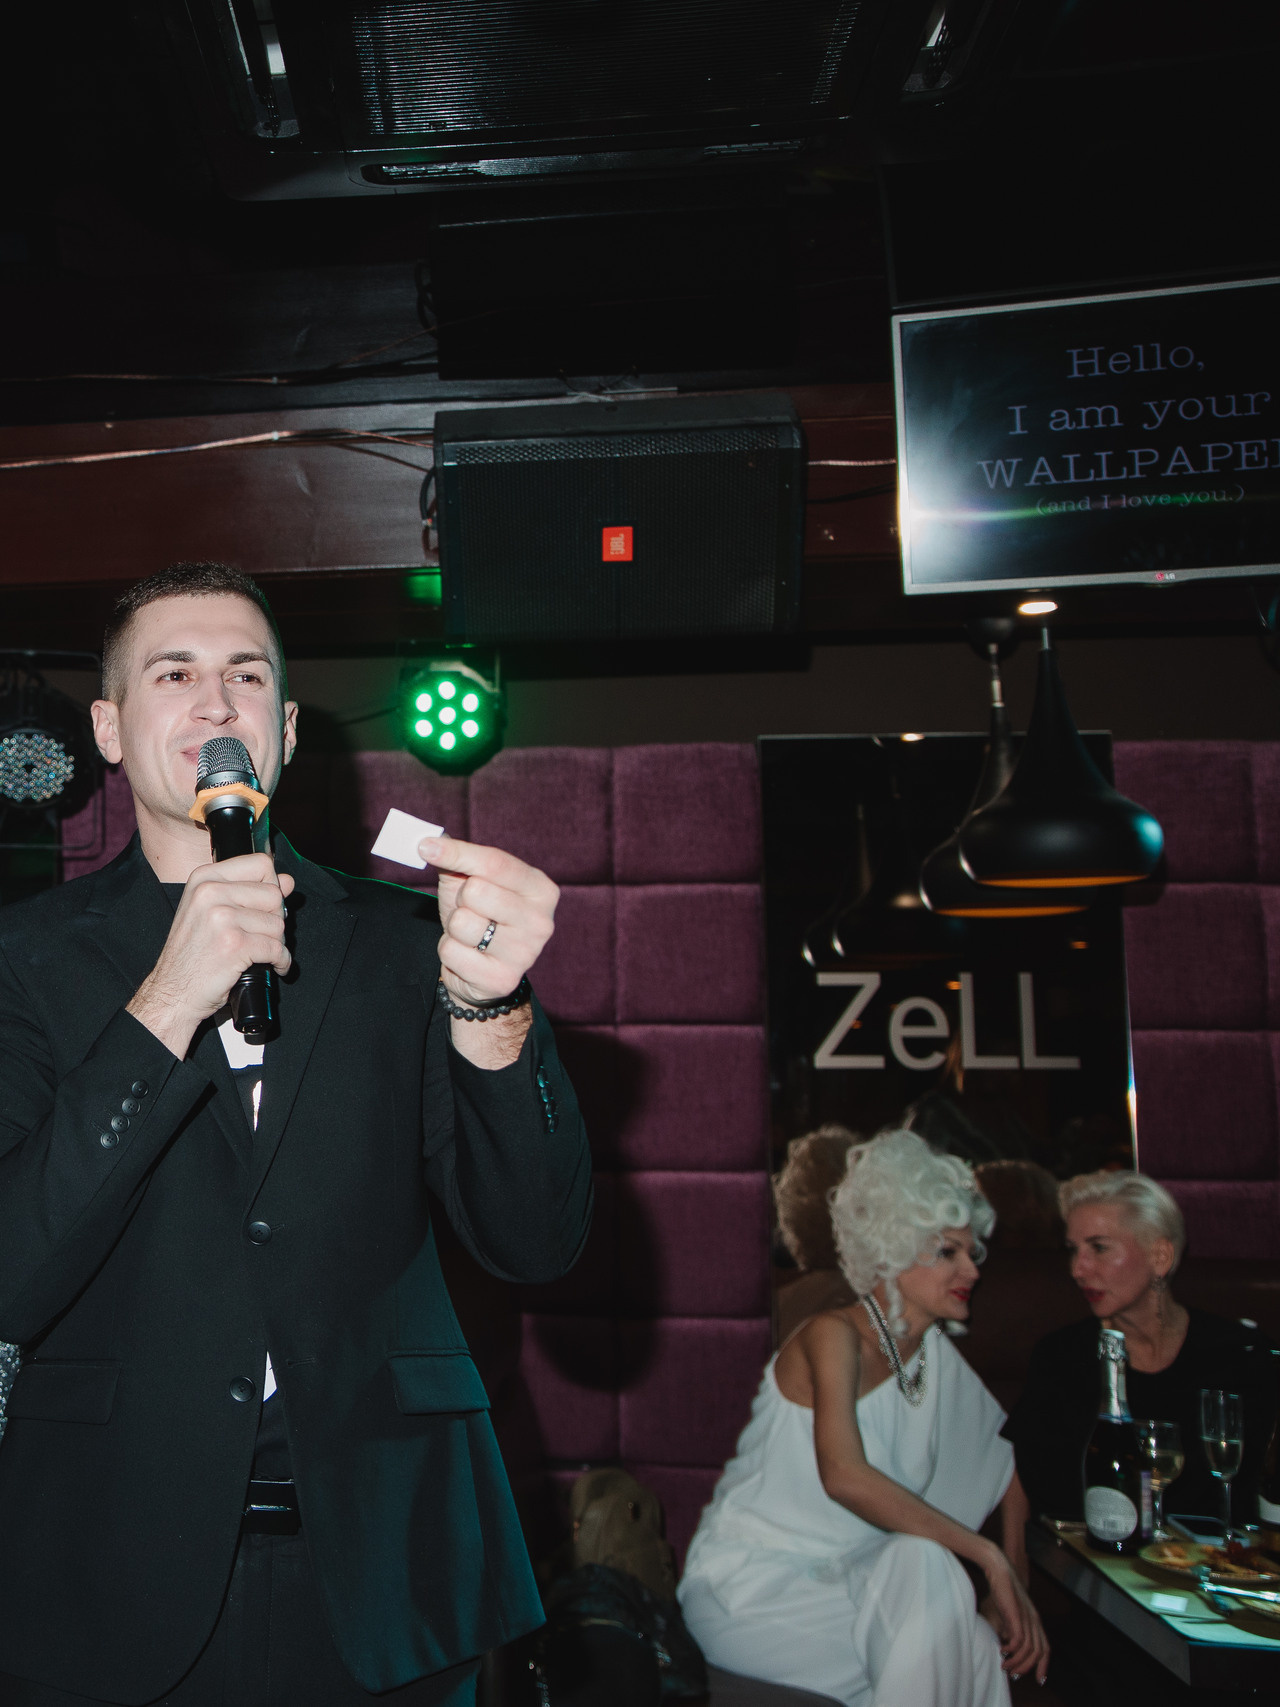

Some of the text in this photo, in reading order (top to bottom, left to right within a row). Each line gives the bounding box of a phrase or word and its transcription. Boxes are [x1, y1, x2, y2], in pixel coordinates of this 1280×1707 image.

[1066, 343, 1205, 379] Hello,
[1007, 391, 1271, 435] I am your
[1036, 484, 1245, 516] (and I love you.)
